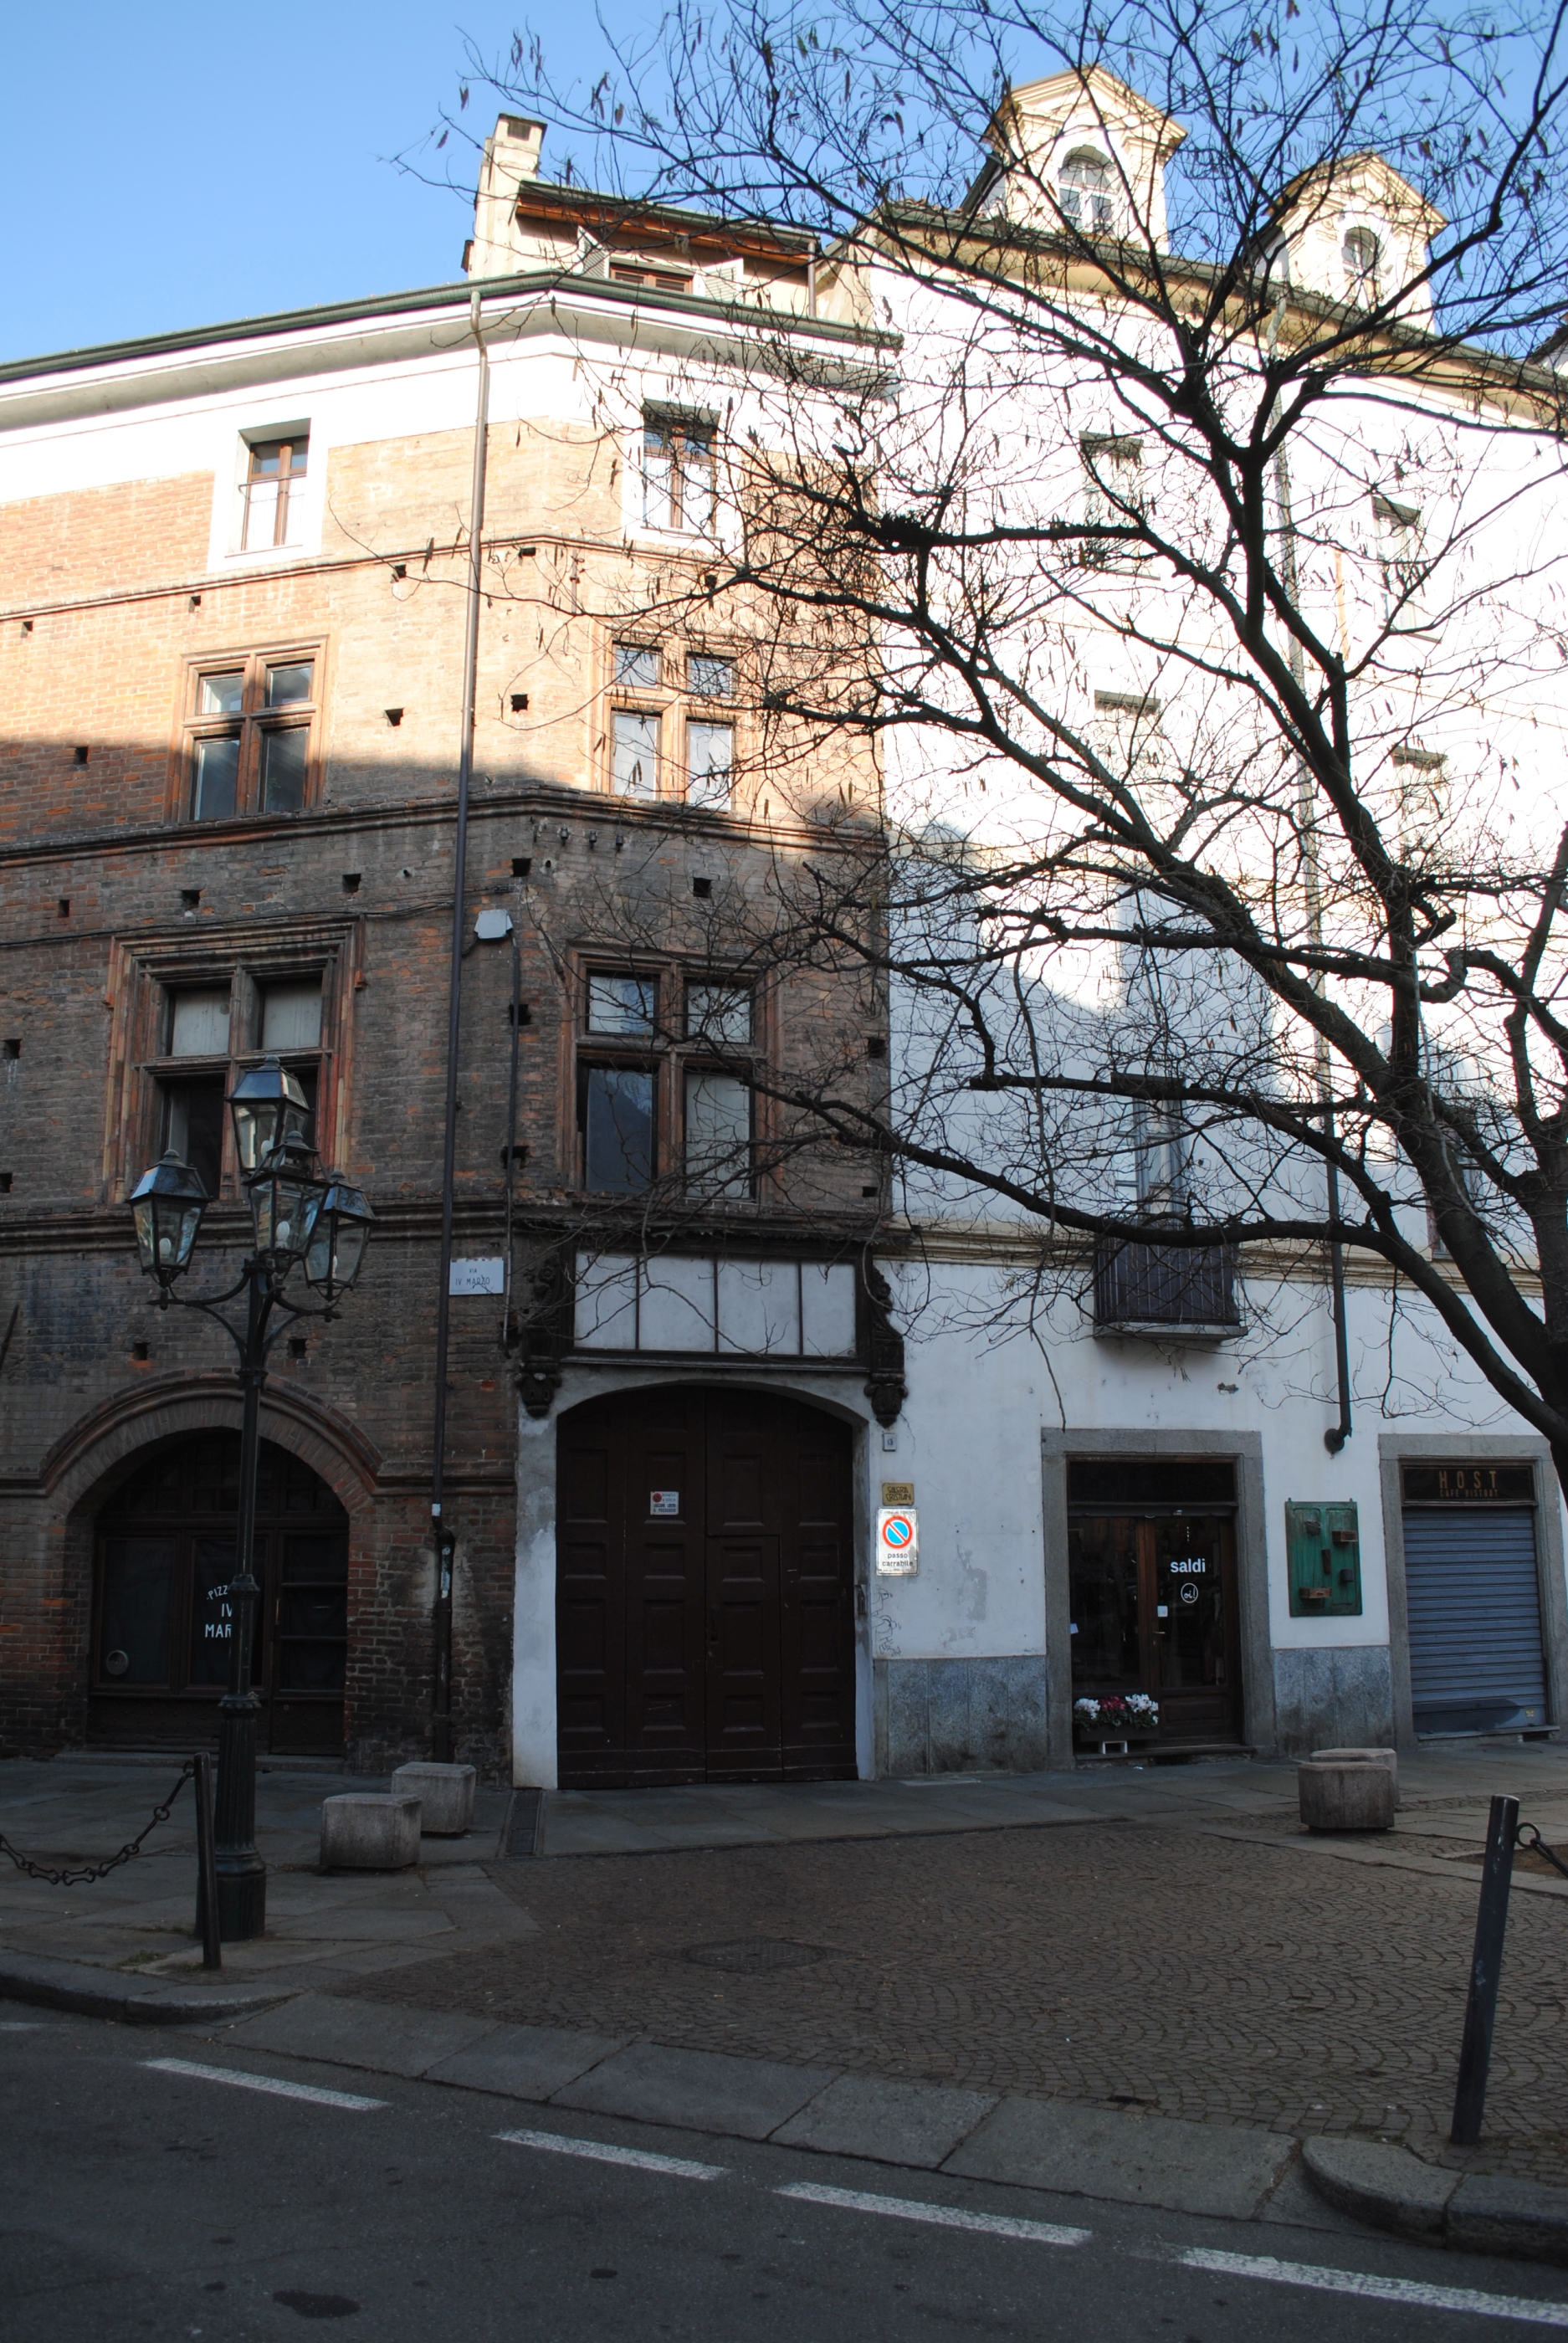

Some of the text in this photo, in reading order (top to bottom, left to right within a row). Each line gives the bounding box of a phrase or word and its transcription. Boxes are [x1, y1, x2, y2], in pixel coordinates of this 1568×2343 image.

[455, 1276, 490, 1286] IV MARZO
[1438, 1469, 1496, 1489] HOST
[1170, 1558, 1206, 1573] saldi
[208, 1584, 228, 1601] PIZZ
[204, 1623, 232, 1638] MAR
